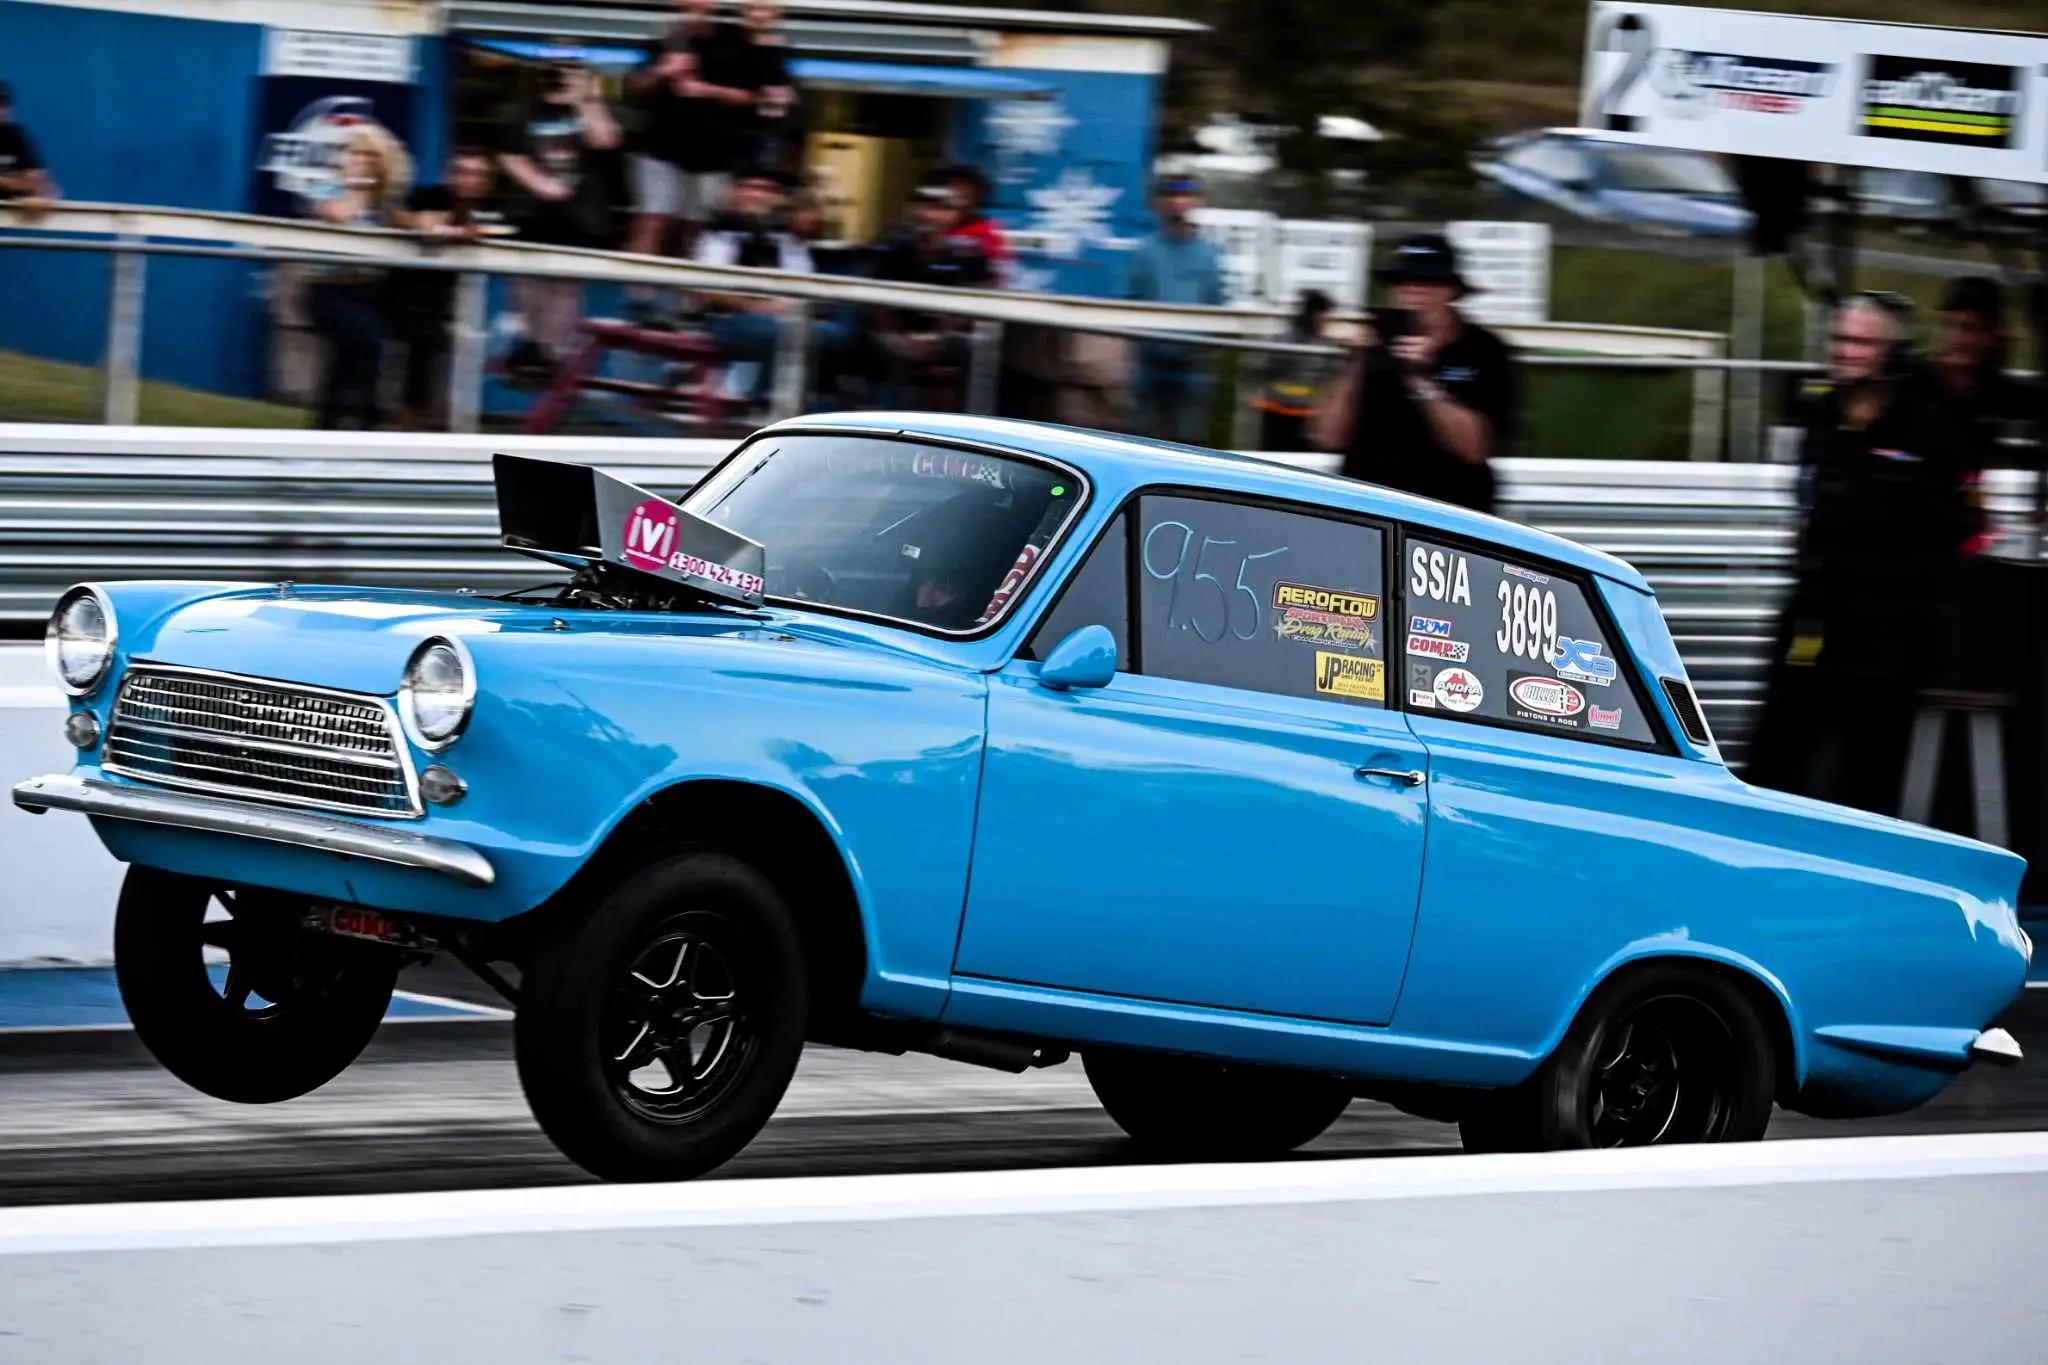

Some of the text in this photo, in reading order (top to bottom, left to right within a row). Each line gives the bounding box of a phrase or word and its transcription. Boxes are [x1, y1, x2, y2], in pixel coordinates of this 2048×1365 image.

[627, 505, 677, 558] ivi
[673, 551, 762, 594] 1300 424 131
[1143, 521, 1289, 643] 9.55
[1411, 547, 1472, 607] SS/A
[1277, 586, 1377, 618] AEROFLOW
[1496, 579, 1557, 664] 3899
[1409, 637, 1454, 655] COMP
[1318, 655, 1342, 690] JP
[1342, 659, 1376, 678] RACING
[1436, 681, 1482, 697] ANDRA
[1517, 710, 1548, 721] PISTONS
[1558, 717, 1578, 727] RODS
